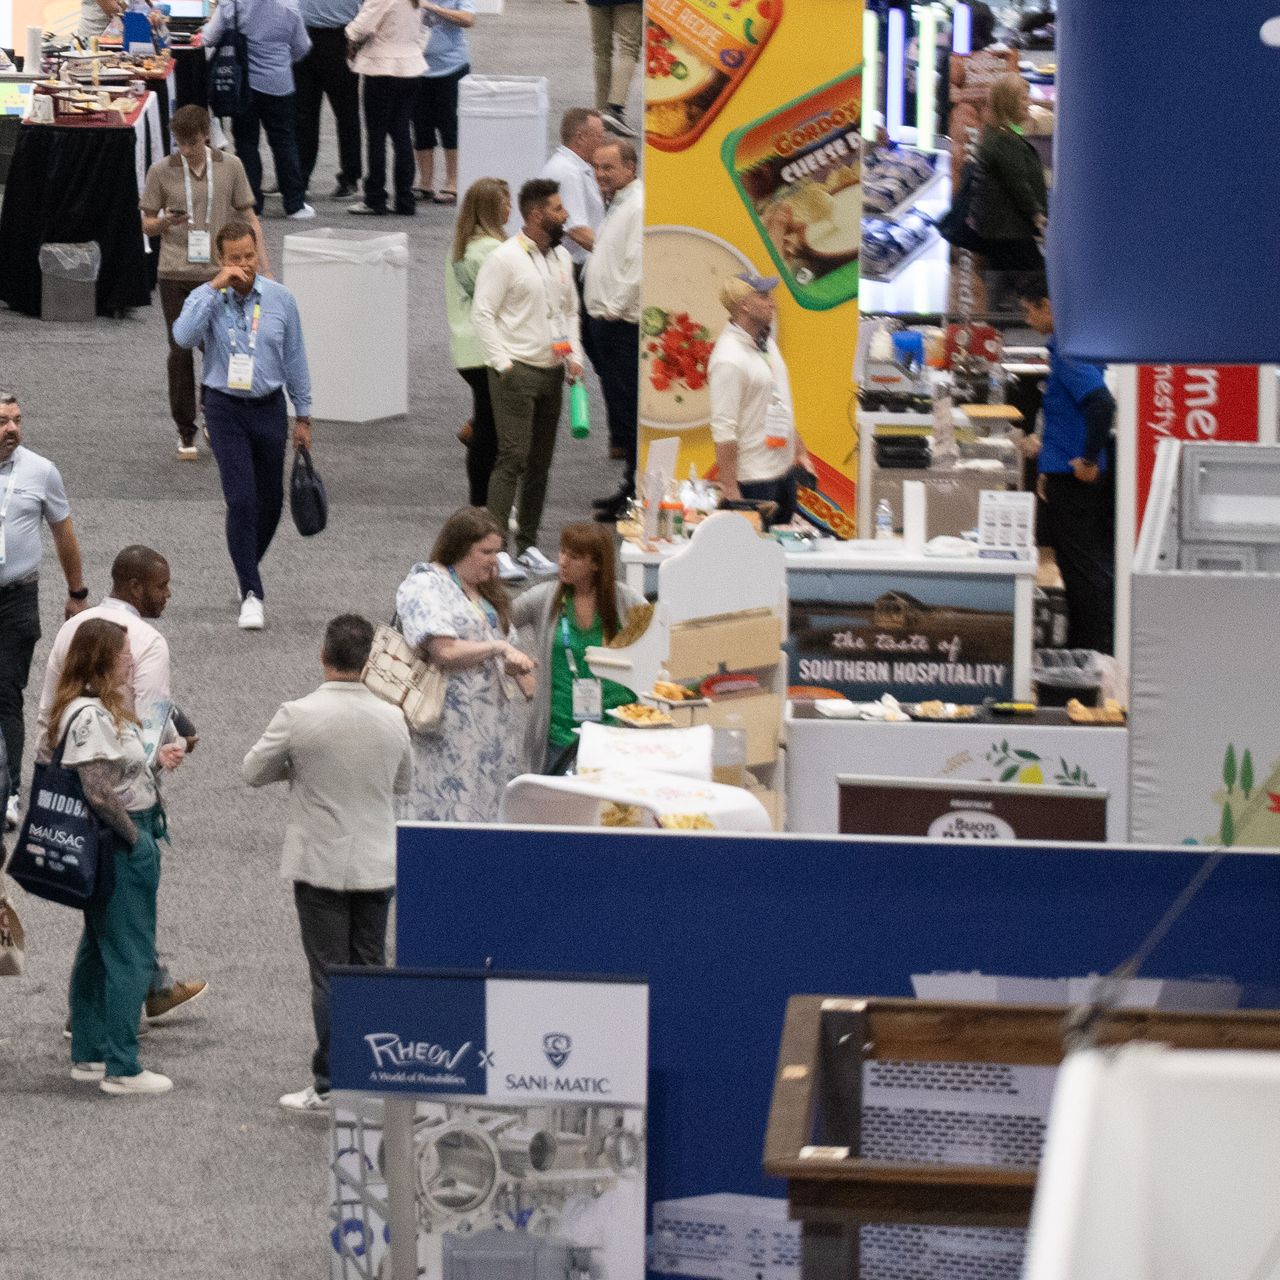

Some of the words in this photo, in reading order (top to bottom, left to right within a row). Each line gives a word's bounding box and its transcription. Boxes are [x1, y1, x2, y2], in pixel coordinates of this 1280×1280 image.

[677, 3, 724, 50] RECIPE
[799, 658, 889, 684] SOUTHERN
[892, 660, 1006, 687] HOSPITALITY
